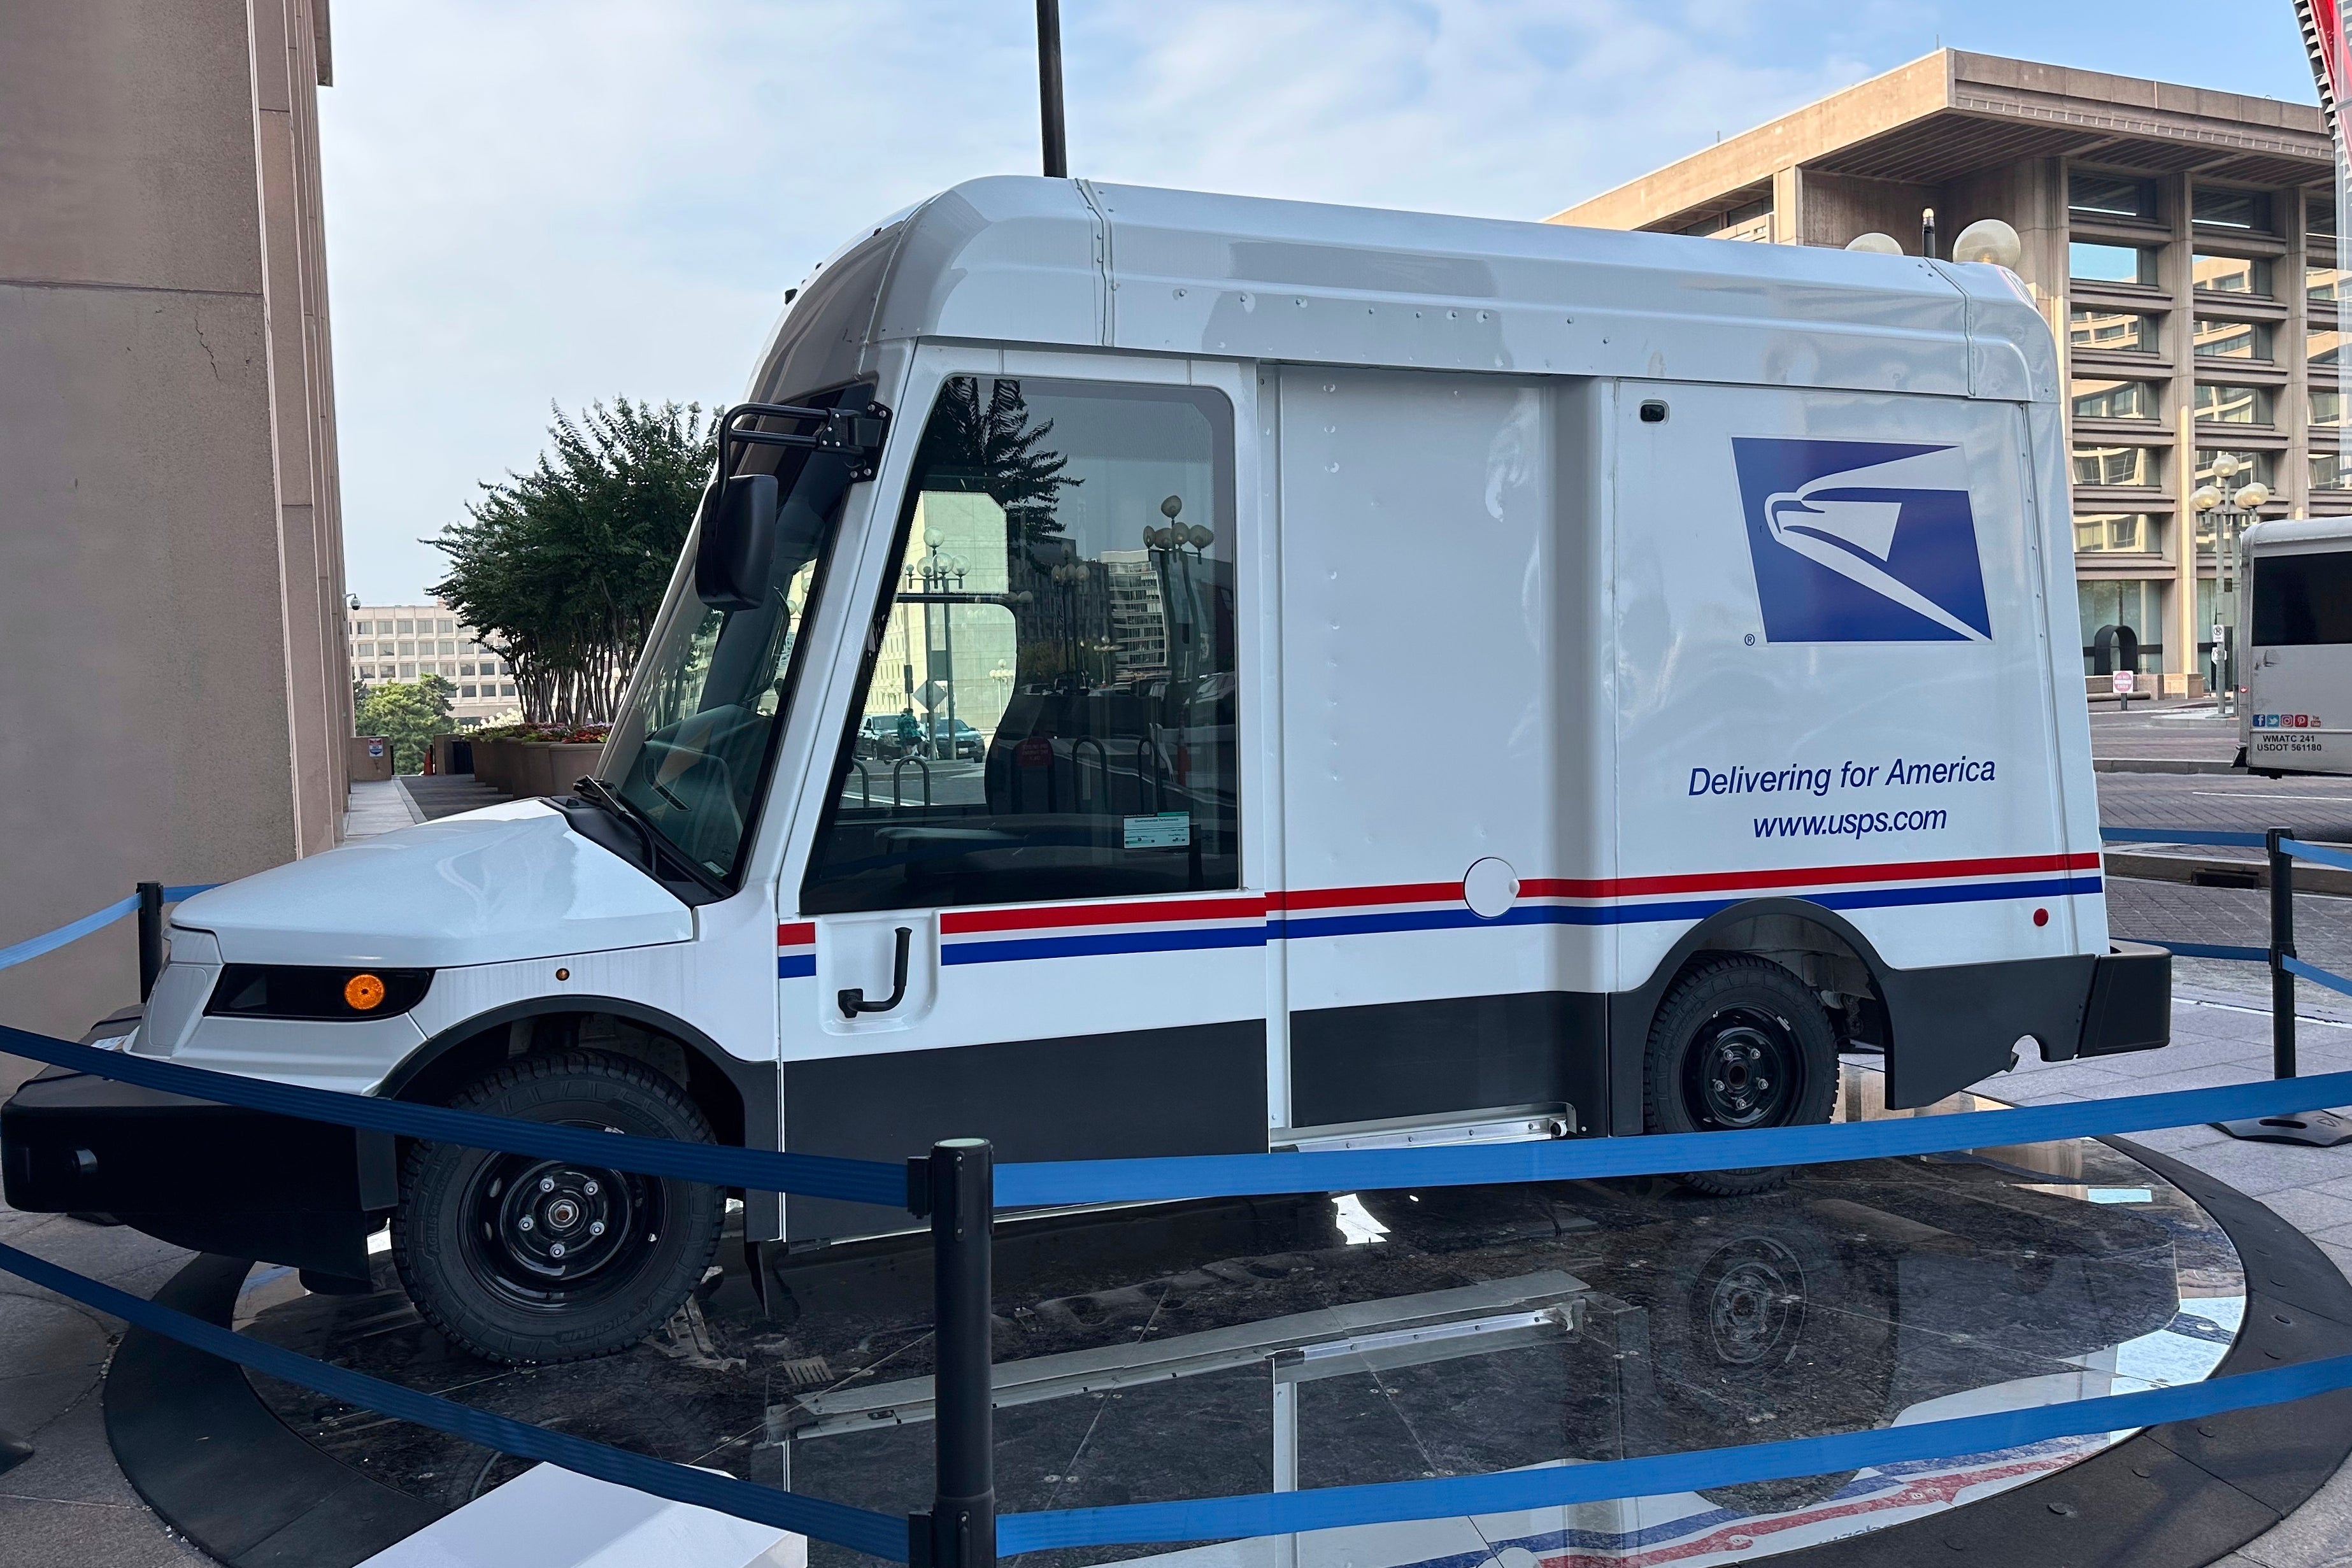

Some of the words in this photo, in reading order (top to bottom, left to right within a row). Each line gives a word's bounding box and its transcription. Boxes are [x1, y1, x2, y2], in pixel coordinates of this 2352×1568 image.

[1688, 763, 1831, 796] Delivering
[1840, 761, 1879, 788] for
[1885, 756, 1996, 786] America
[1753, 809, 1947, 839] www.usps.com
